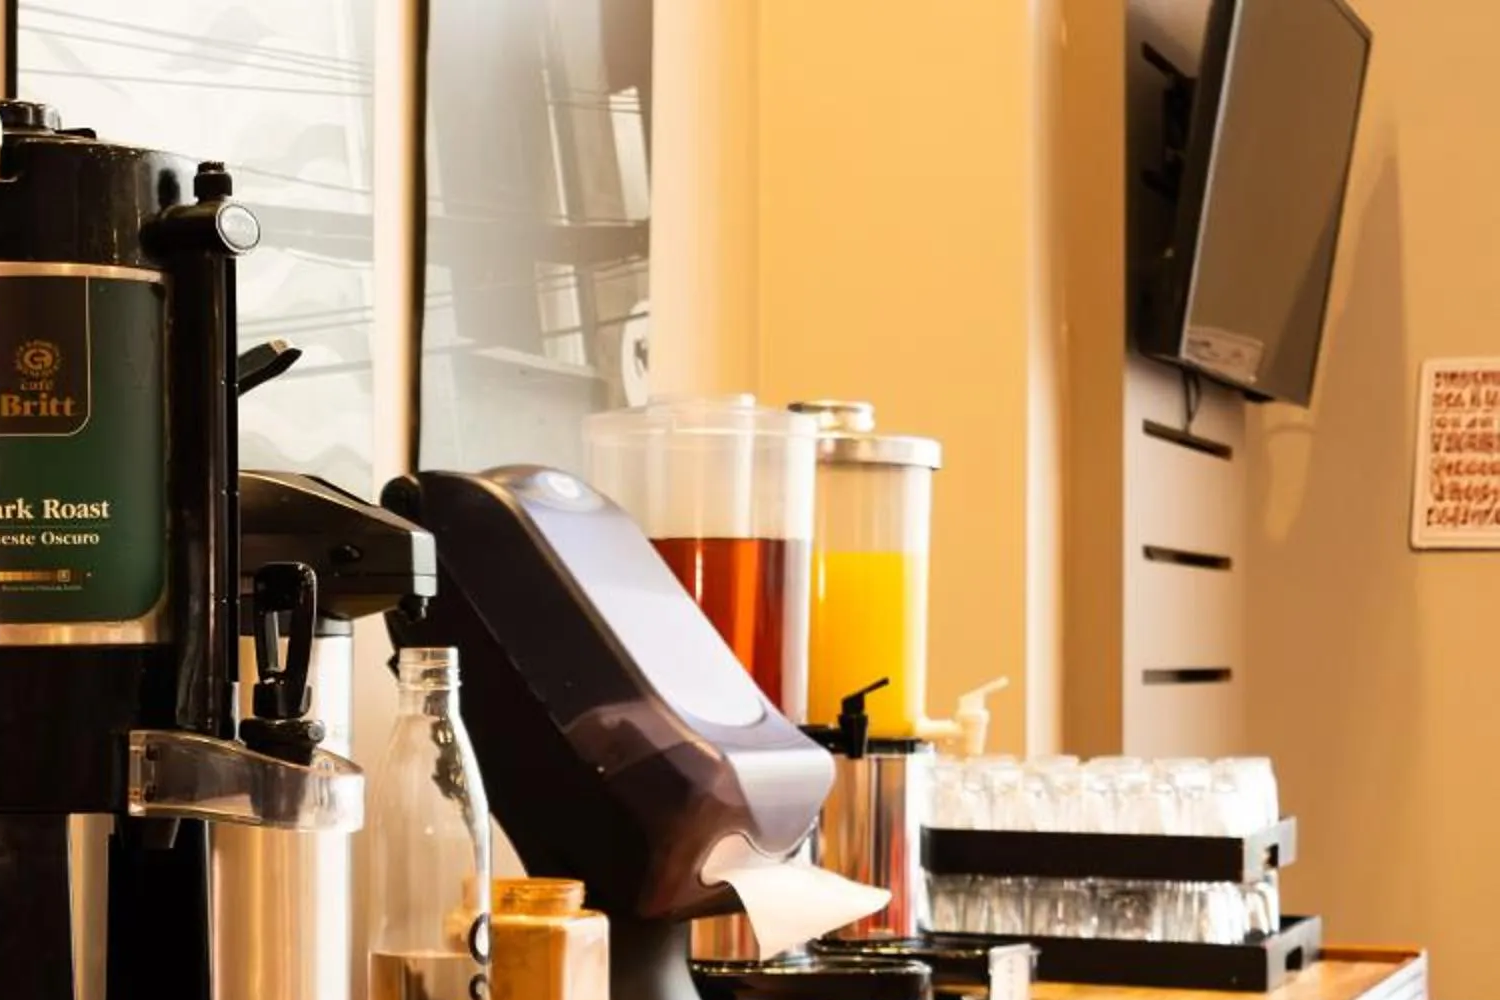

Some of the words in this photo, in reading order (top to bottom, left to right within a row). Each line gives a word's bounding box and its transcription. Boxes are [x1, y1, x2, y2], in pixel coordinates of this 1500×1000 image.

[0, 393, 77, 418] Britt
[42, 499, 110, 519] Roast
[41, 531, 100, 545] Oscuro
